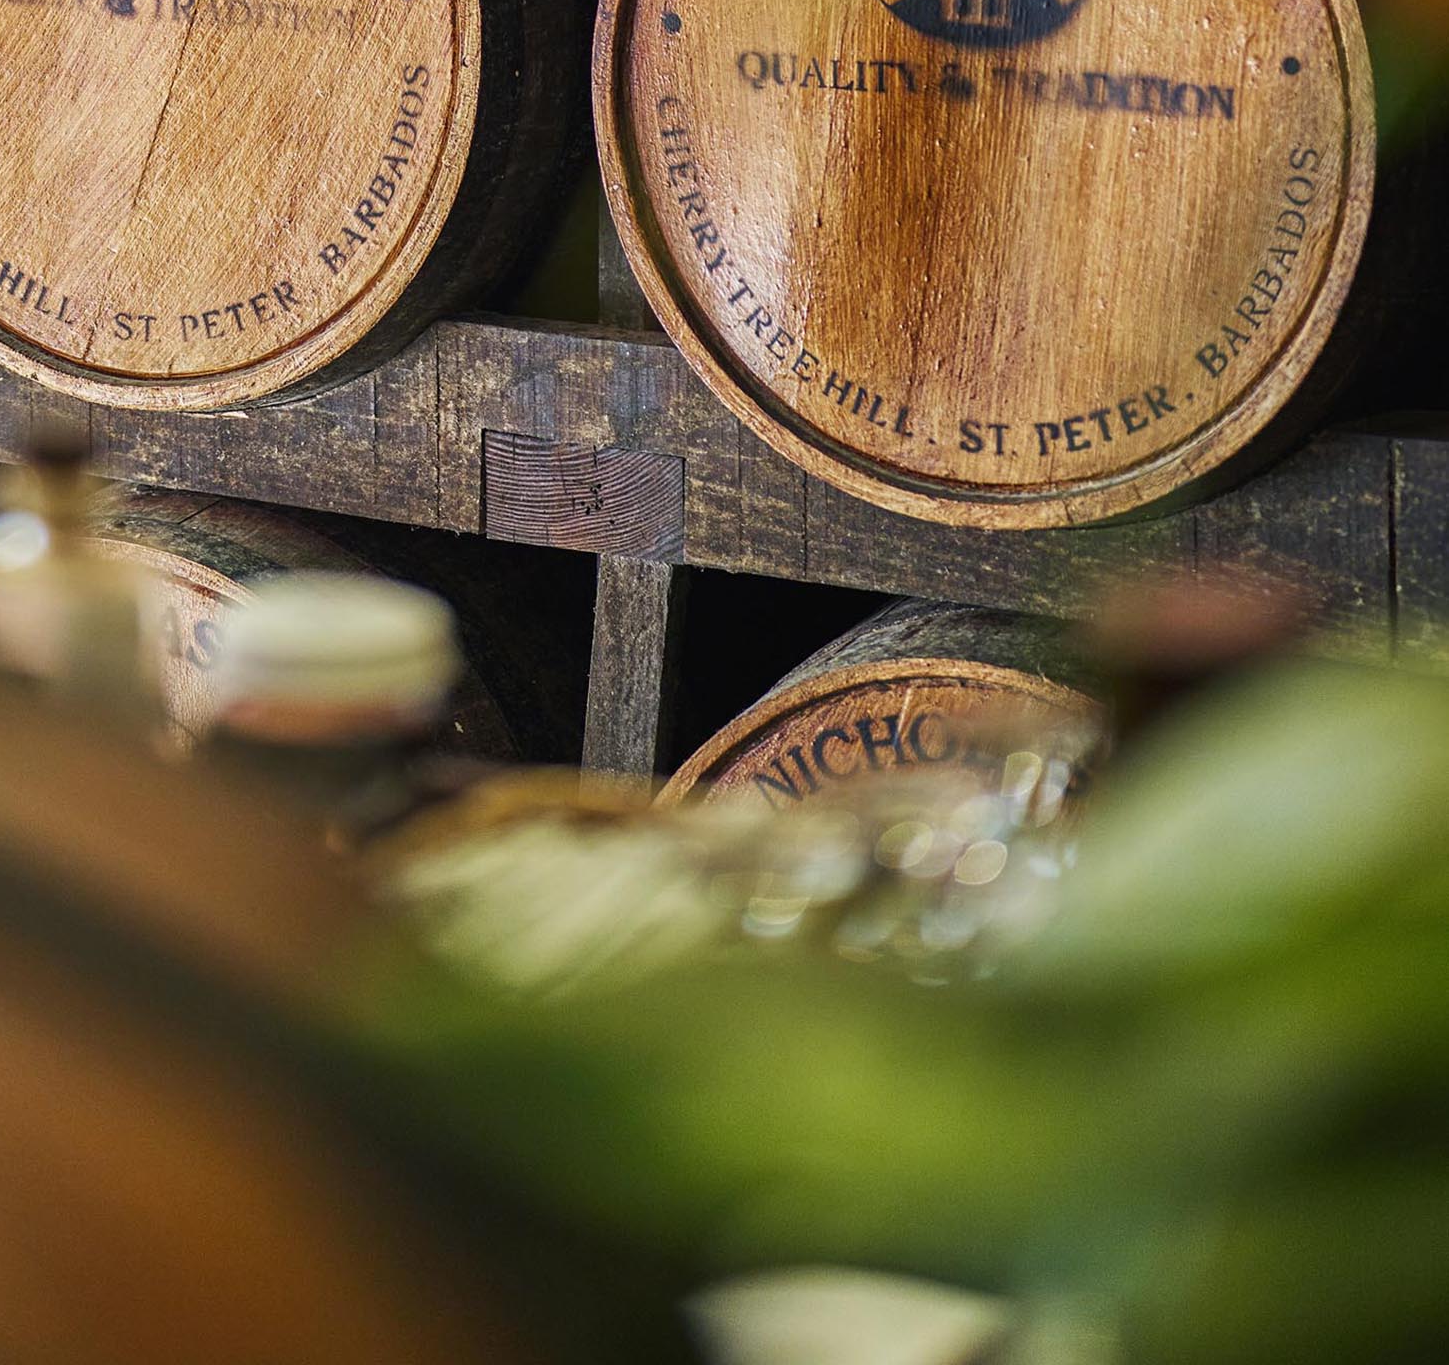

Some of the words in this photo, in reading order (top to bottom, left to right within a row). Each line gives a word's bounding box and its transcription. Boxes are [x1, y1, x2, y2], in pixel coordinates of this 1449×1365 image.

[737, 51, 919, 95] QUALITY
[181, 280, 300, 343] PETER
[319, 63, 430, 275] BARBADOS
[658, 97, 732, 275] CHERRY
[728, 278, 821, 383] TREE
[822, 371, 914, 437] HILL
[960, 421, 1018, 456] ST.
[1196, 145, 1320, 380] BARBADOS
[753, 709, 958, 809] NICHO
